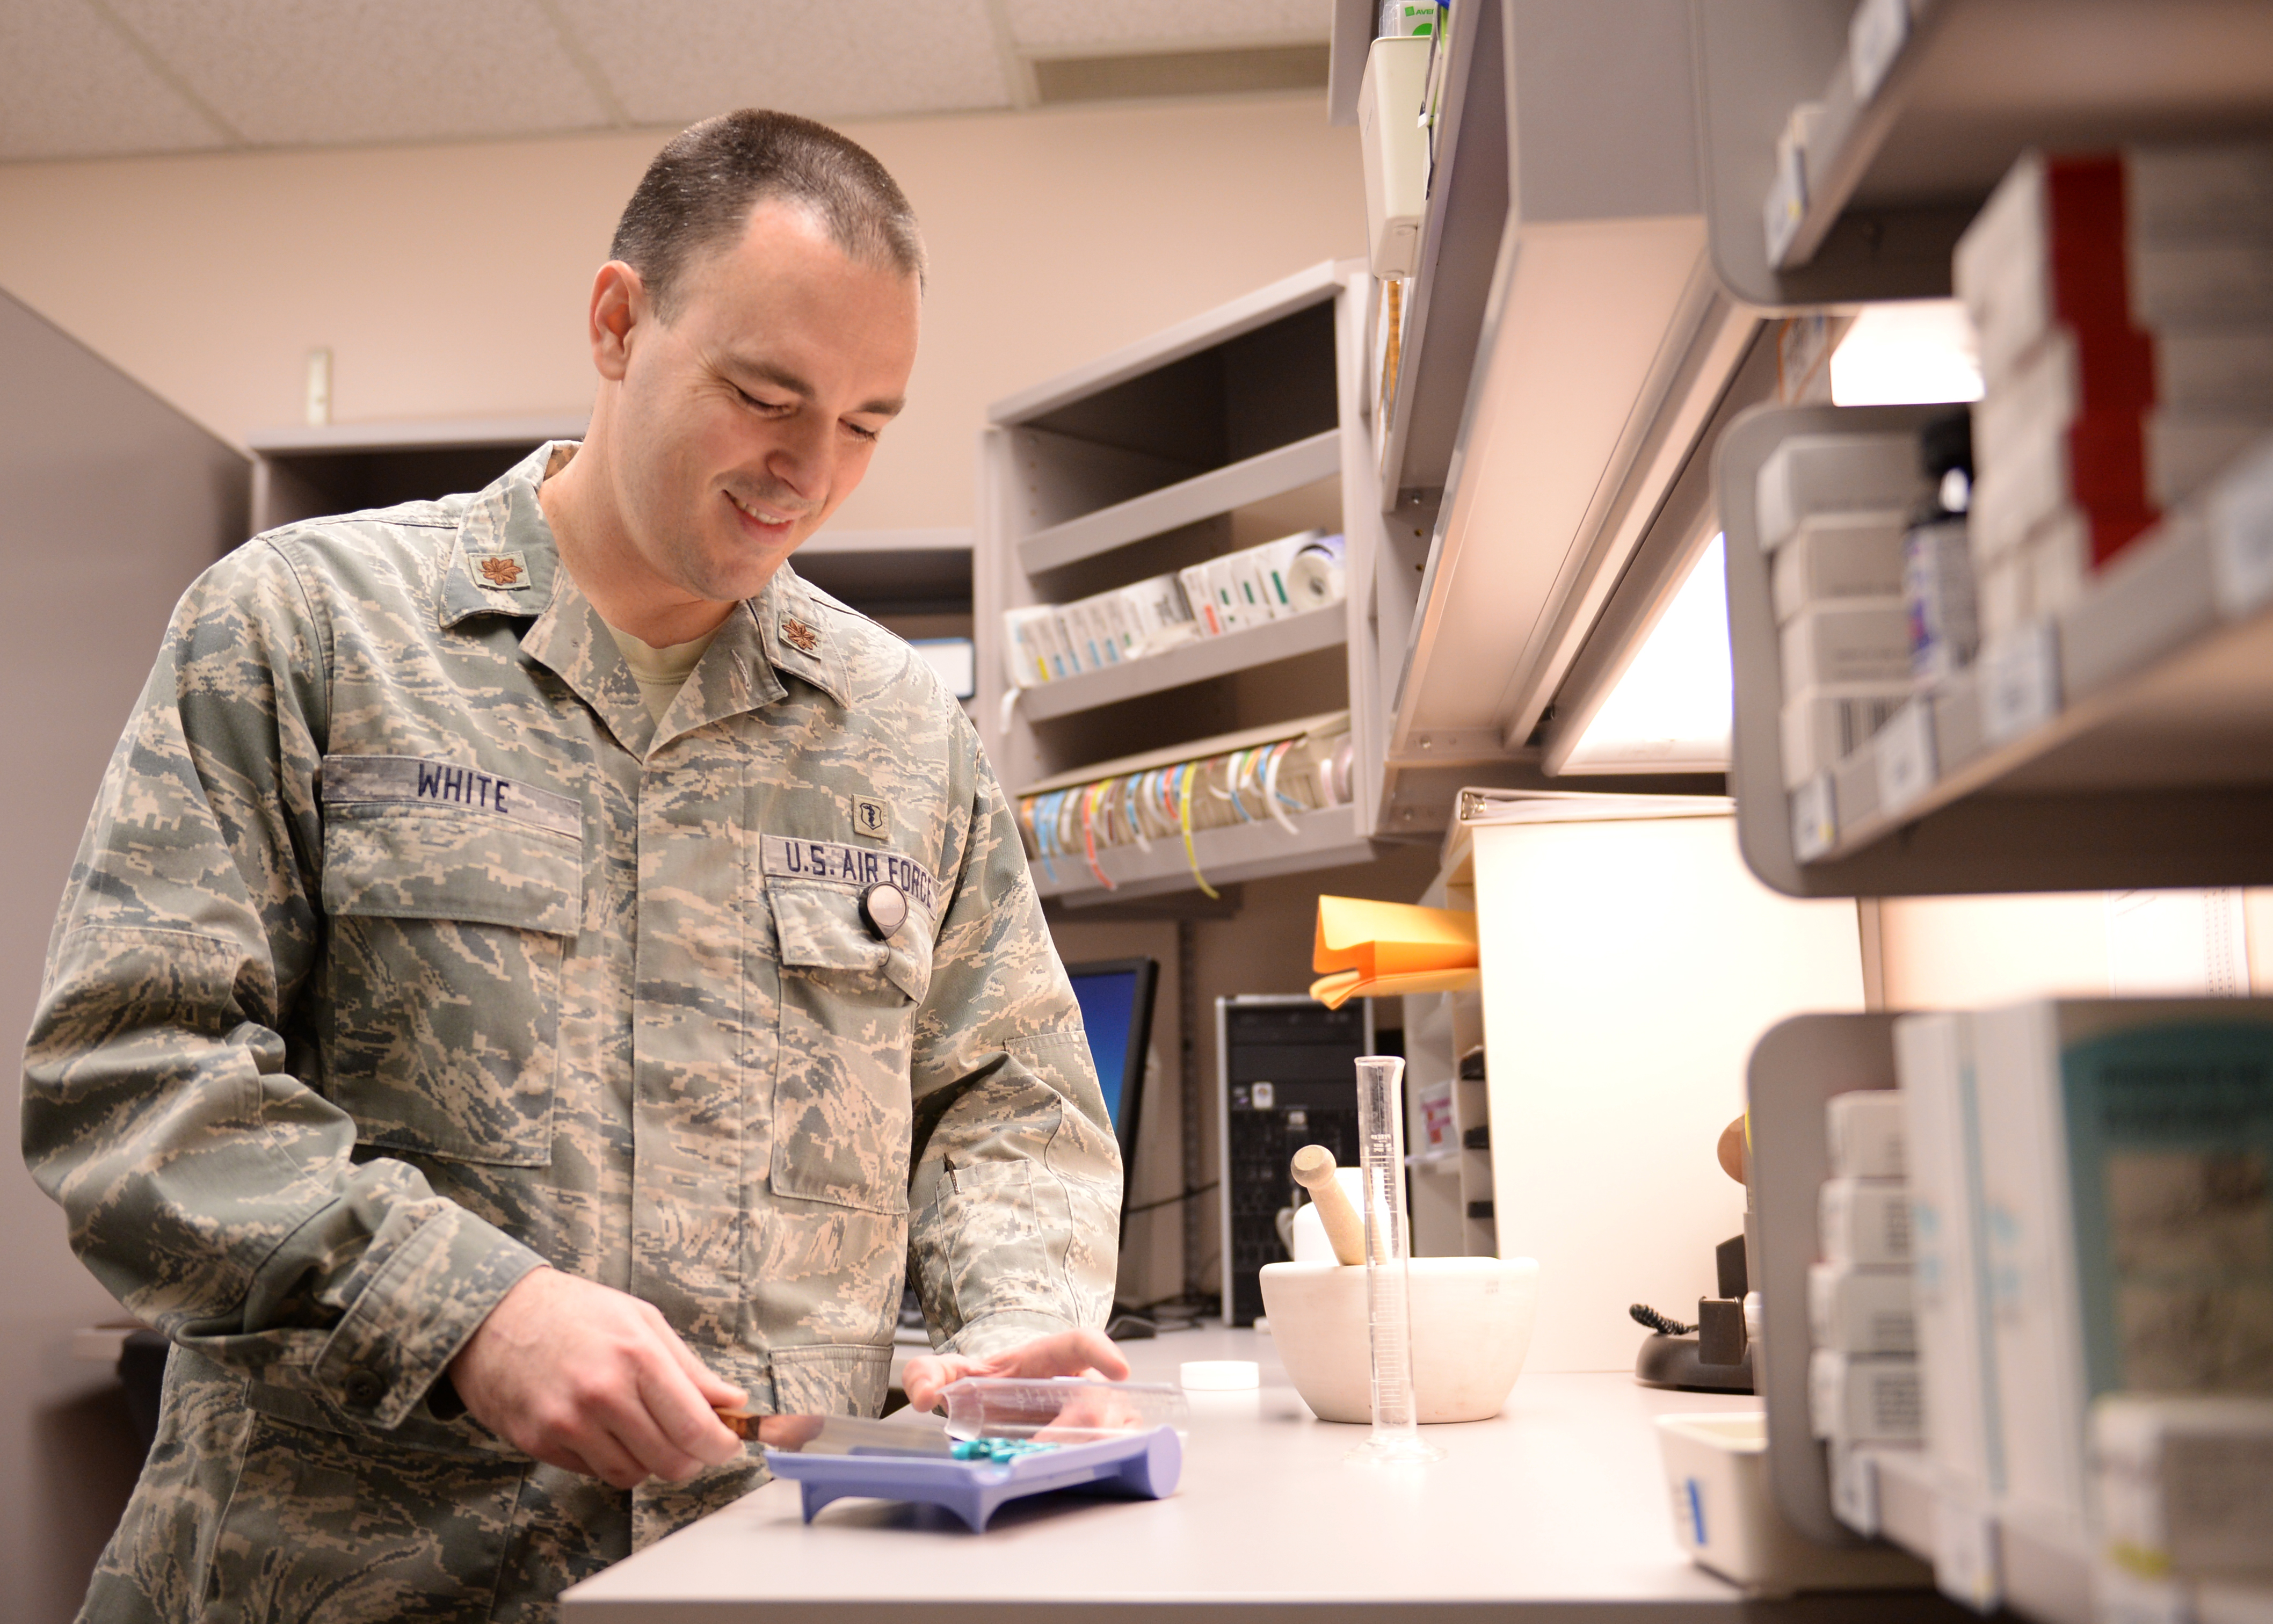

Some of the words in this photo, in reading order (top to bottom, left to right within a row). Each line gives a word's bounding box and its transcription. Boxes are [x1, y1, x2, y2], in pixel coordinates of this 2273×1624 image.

[418, 763, 509, 813] WHITE
[785, 842, 834, 876] U.S.
[843, 849, 878, 882] AIR
[888, 857, 933, 909] FORCE
